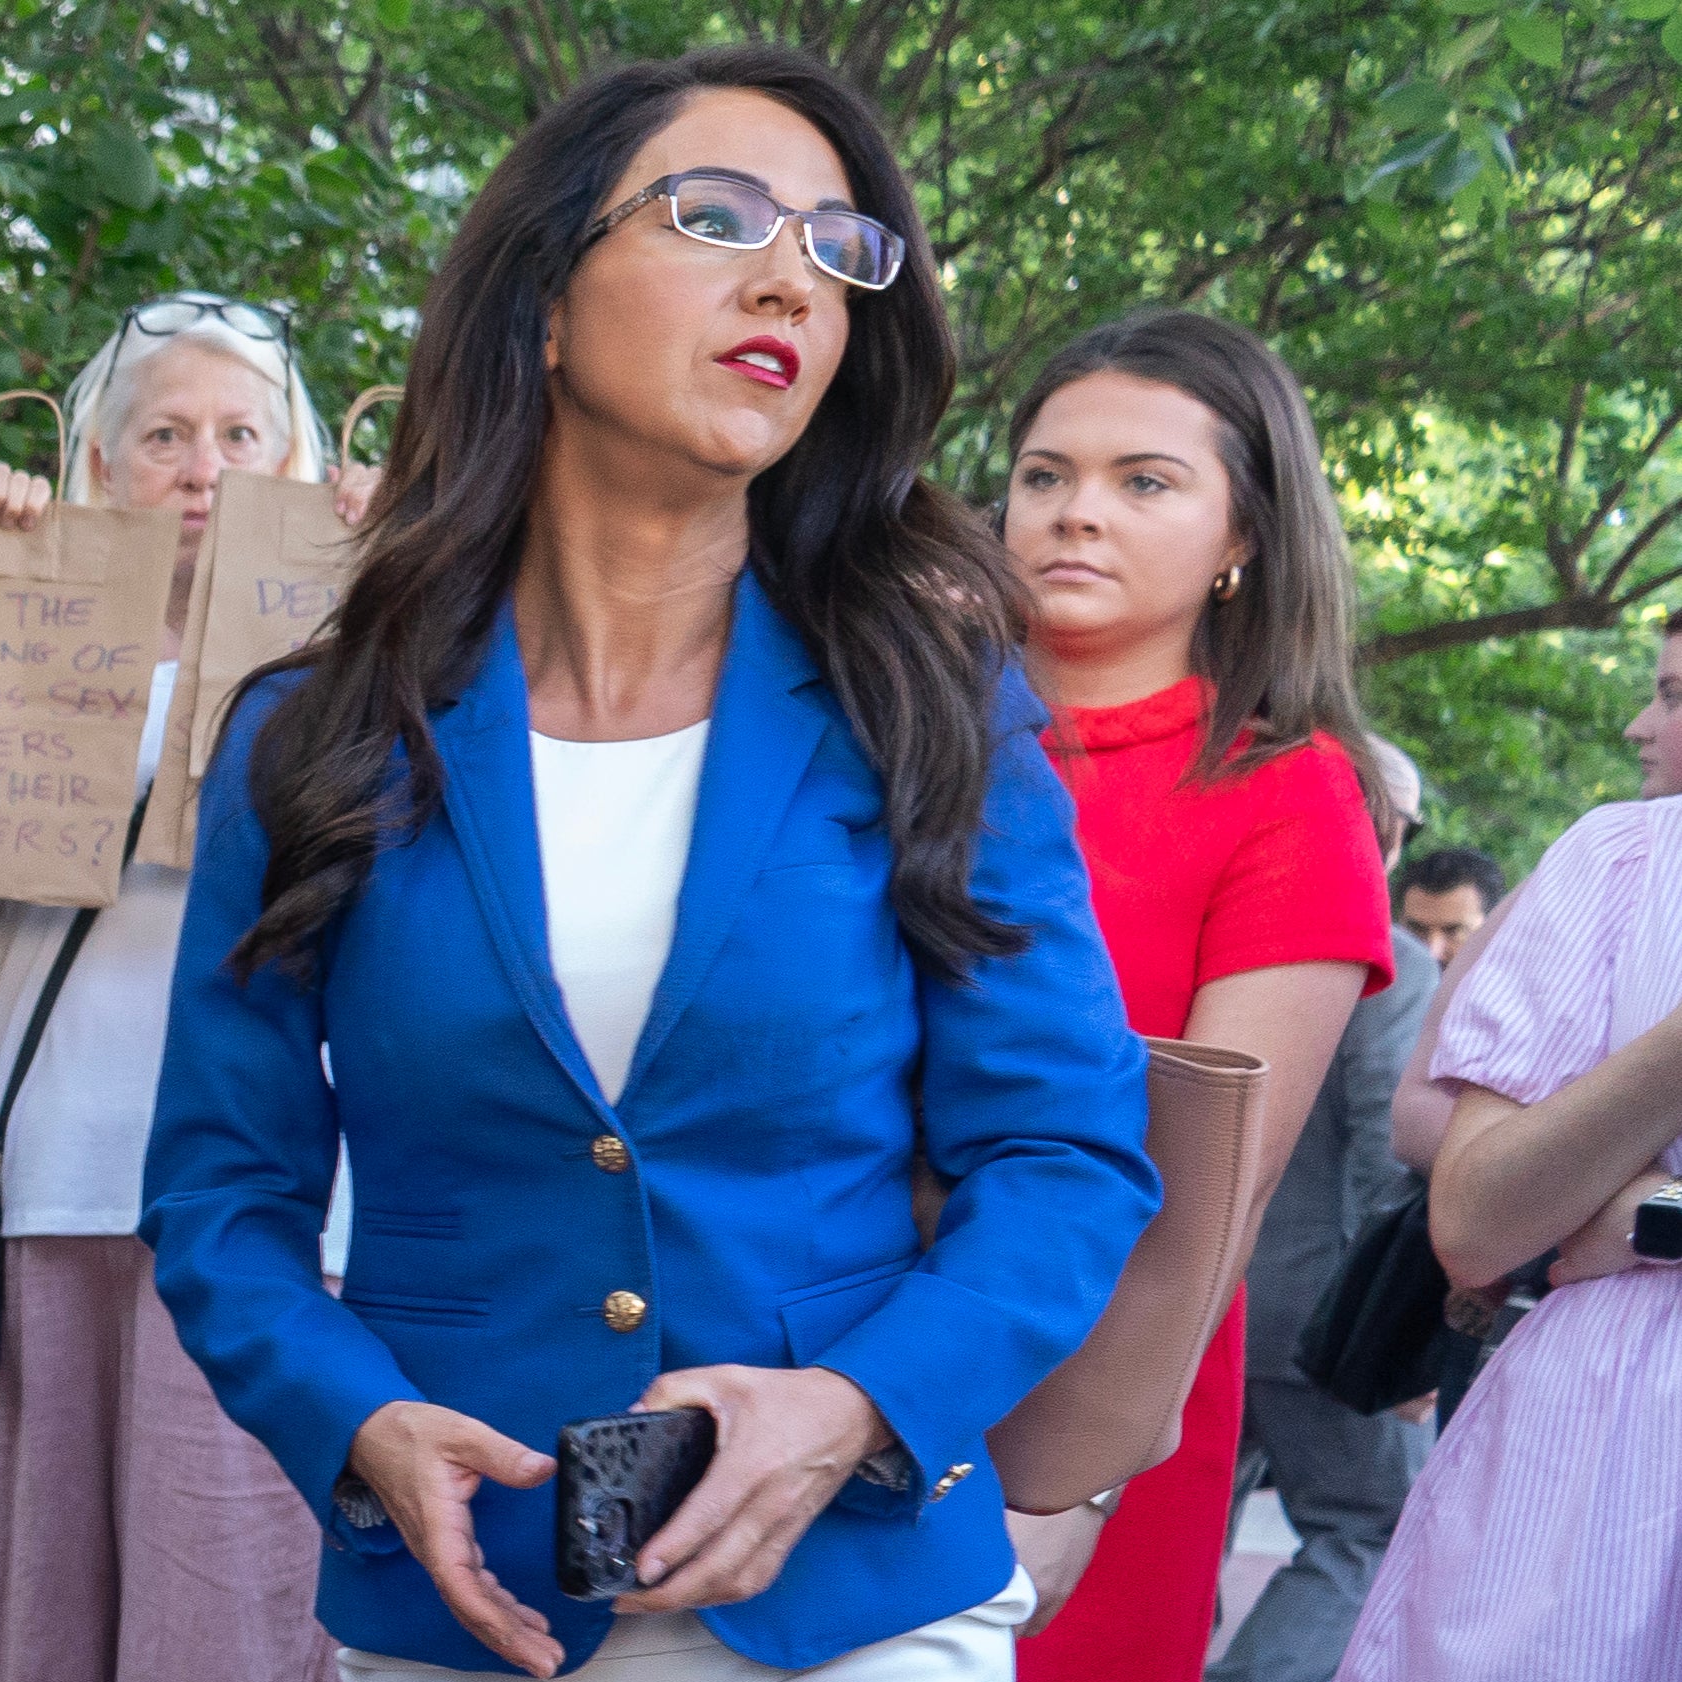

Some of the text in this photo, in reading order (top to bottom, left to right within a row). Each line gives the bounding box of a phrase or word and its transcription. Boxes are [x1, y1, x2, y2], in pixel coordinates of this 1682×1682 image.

[5, 590, 96, 630] THE
[71, 643, 142, 675] OF
[47, 679, 137, 721] SEX
